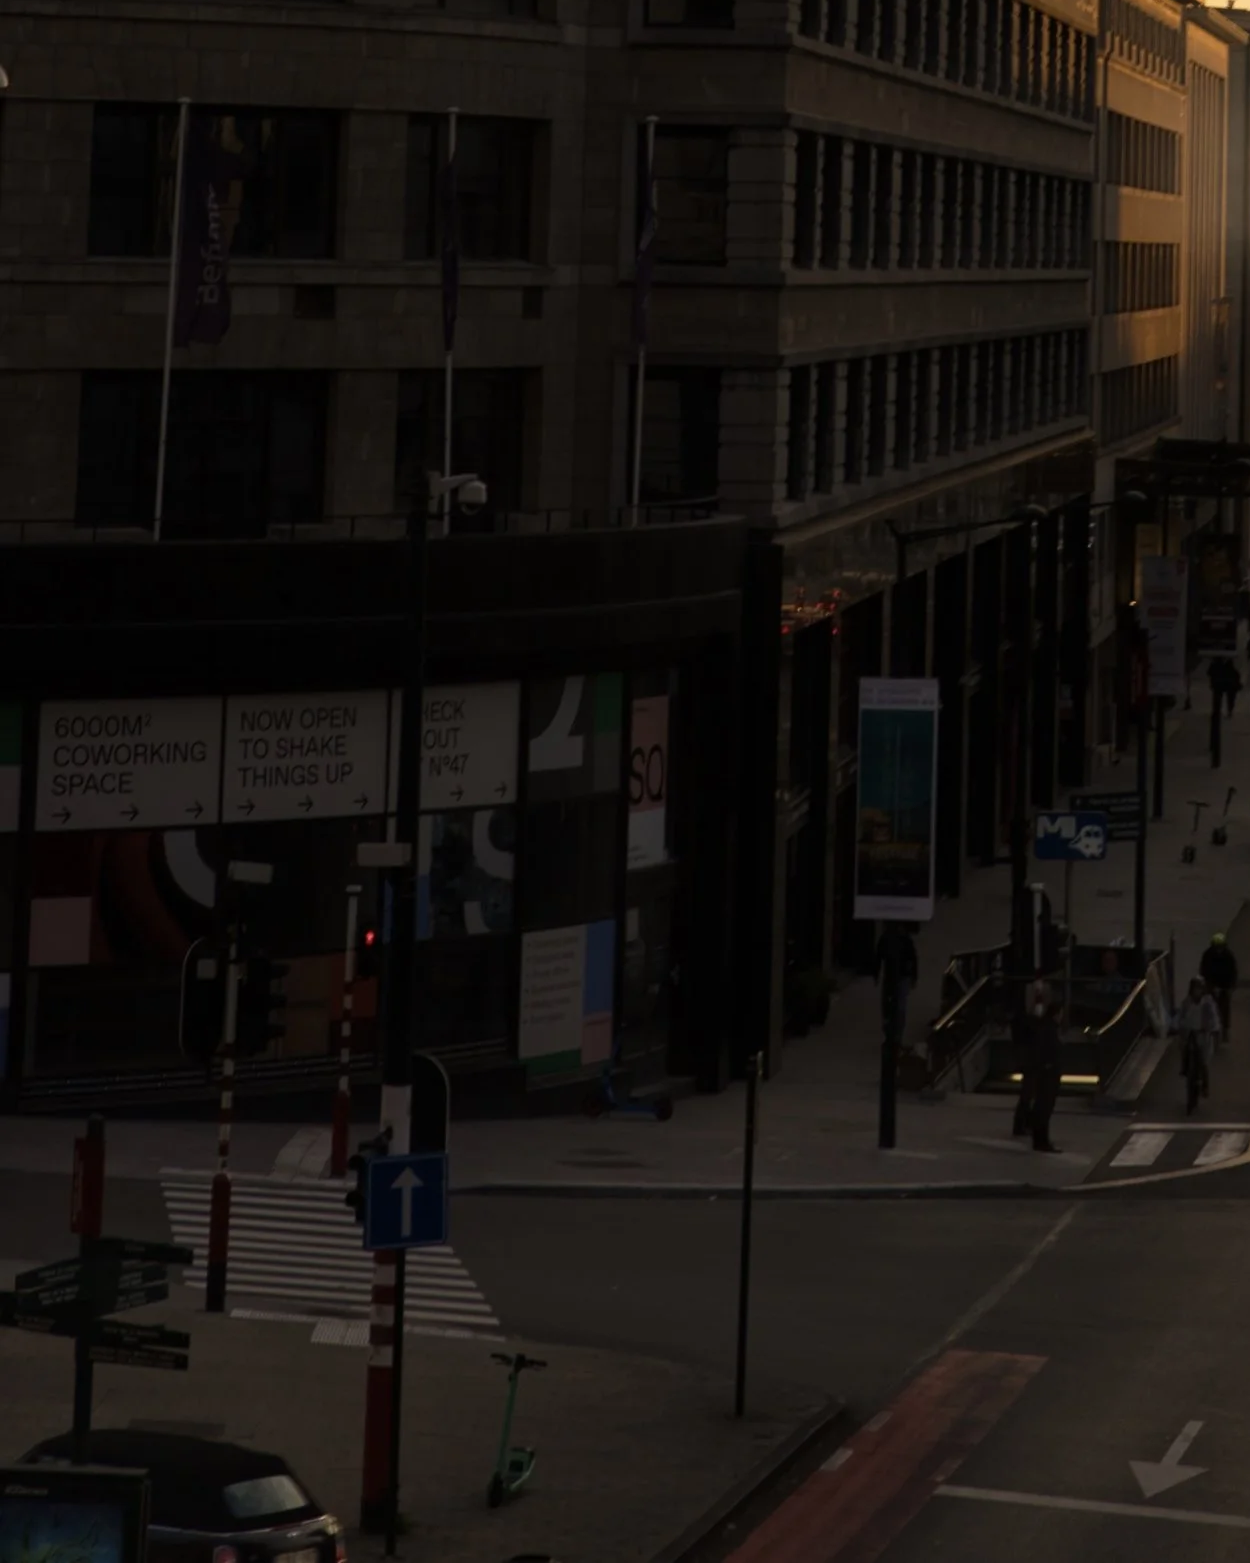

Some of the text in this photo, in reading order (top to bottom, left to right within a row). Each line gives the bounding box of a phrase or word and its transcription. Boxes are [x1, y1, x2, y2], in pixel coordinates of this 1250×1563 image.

[240, 706, 357, 732] NOW OPEN
[239, 735, 348, 760] TO SHAKE
[423, 726, 461, 750] OUT
[53, 741, 207, 767] COWORKING
[51, 772, 134, 796] SPACE
[238, 762, 354, 788] THINGS UP
[1036, 815, 1077, 838] M
